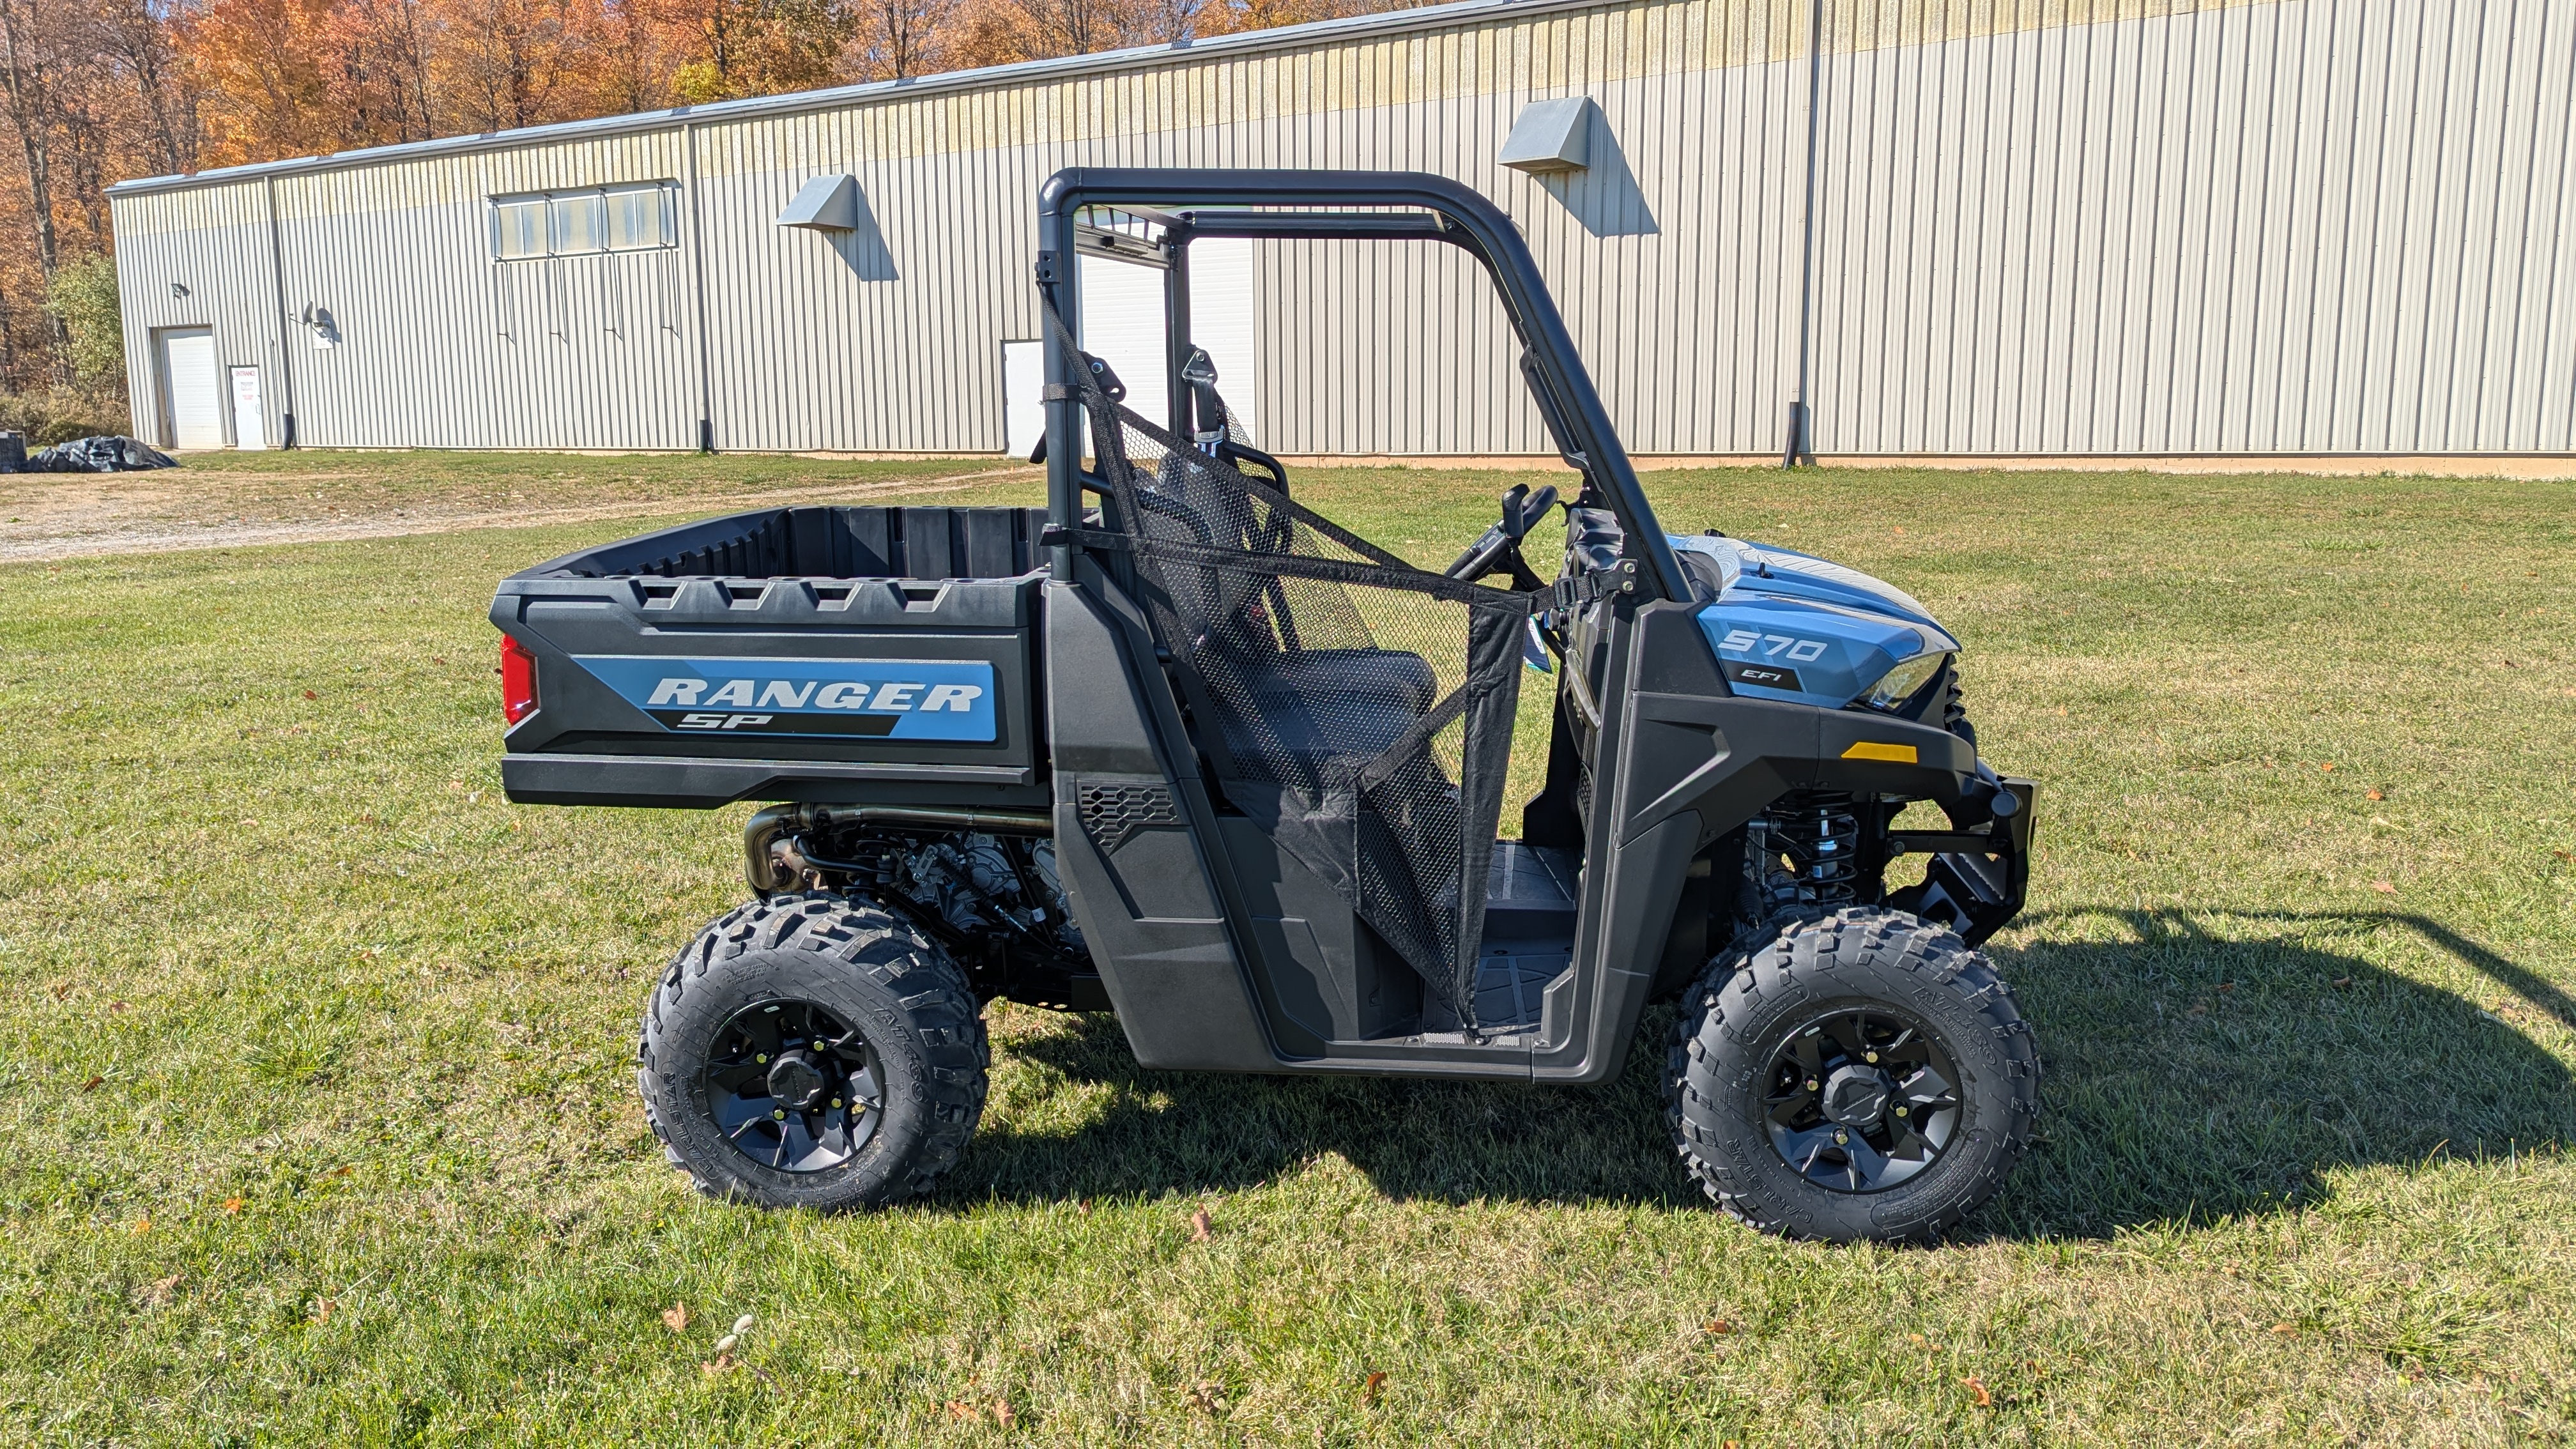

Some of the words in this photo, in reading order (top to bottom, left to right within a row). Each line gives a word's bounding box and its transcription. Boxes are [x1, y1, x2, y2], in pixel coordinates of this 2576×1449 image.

[1717, 629, 1828, 662] 570
[1740, 669, 1782, 682] EFI
[647, 678, 983, 712] RANGER
[677, 714, 774, 730] SP
[663, 1071, 714, 1173] CARLSTAR
[1726, 1138, 1813, 1223] CARLSTAR
